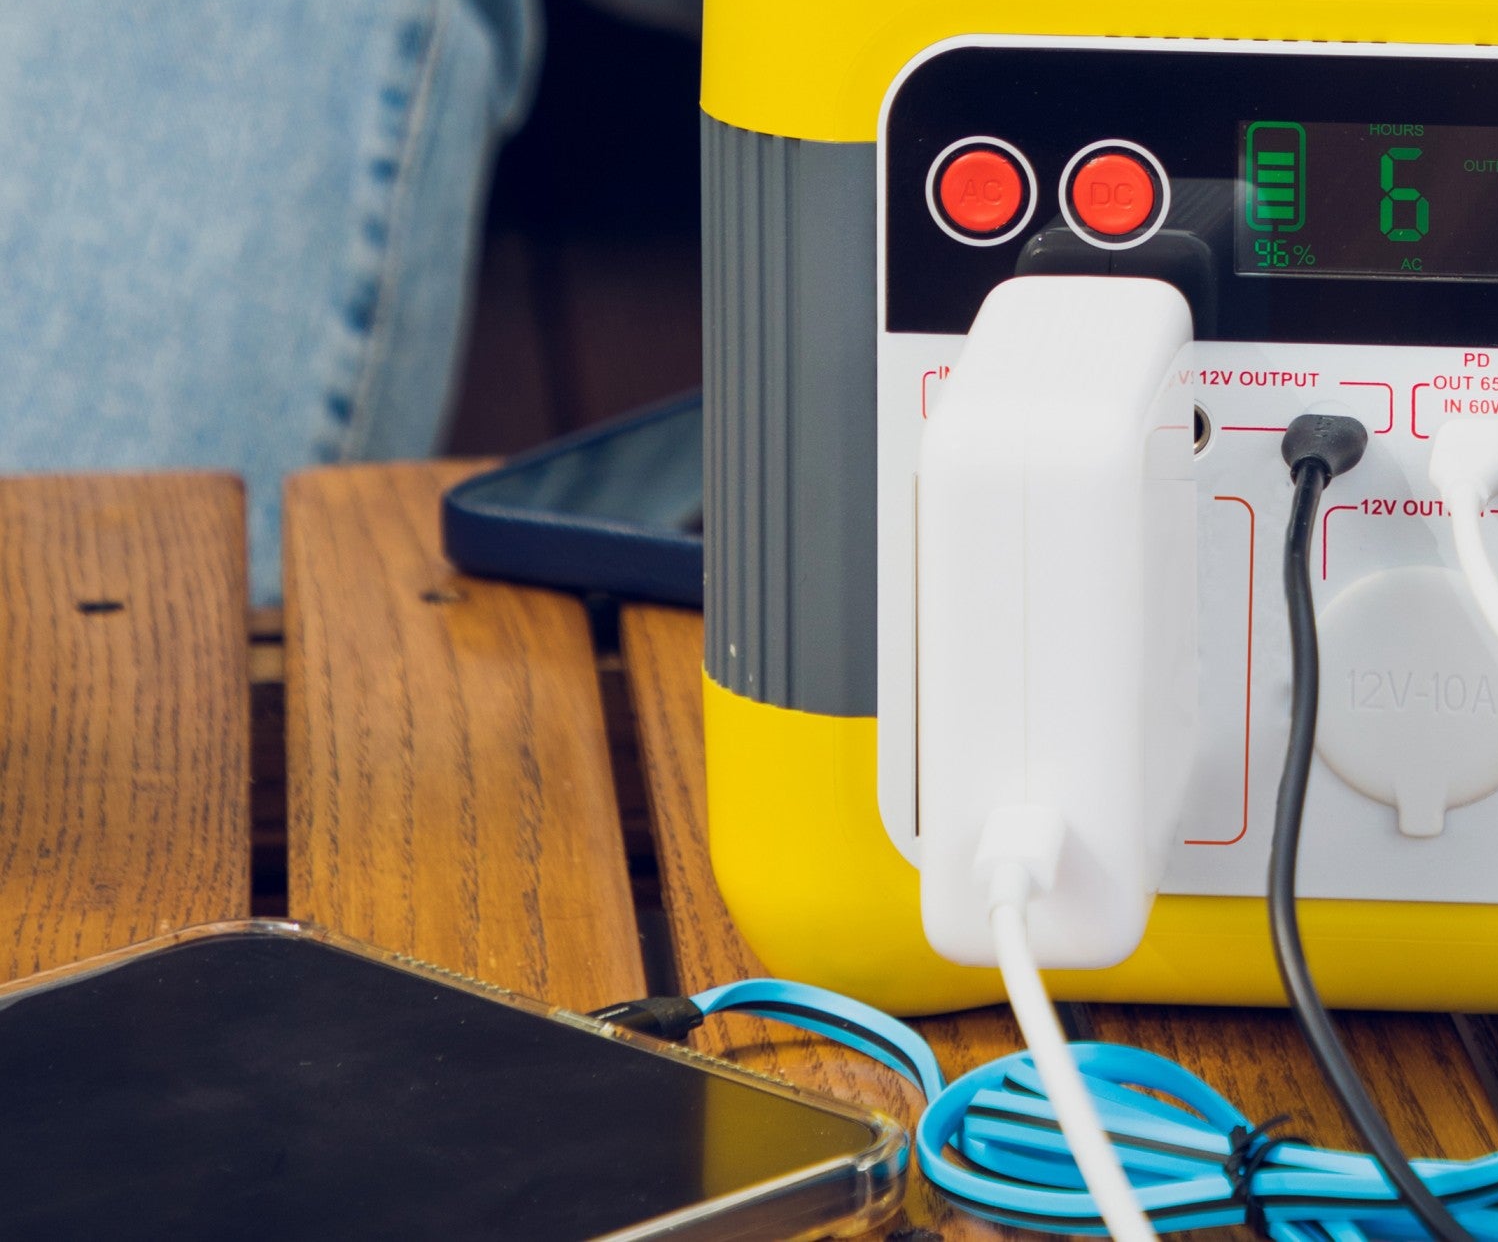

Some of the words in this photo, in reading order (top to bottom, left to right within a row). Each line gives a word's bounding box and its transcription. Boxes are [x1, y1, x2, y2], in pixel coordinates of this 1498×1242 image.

[1369, 123, 1424, 137] HOURS
[959, 179, 1003, 206] AC
[1090, 182, 1133, 208] DC
[1380, 147, 1429, 242] 6
[1400, 257, 1423, 271] AC
[1464, 352, 1490, 368] PD
[1199, 370, 1233, 386] 12V
[1239, 371, 1320, 387] OUTPUT
[1433, 375, 1474, 390] OUT
[1443, 398, 1462, 413] IN
[1360, 499, 1397, 515] 12V
[1347, 669, 1497, 714] 12V-10A
